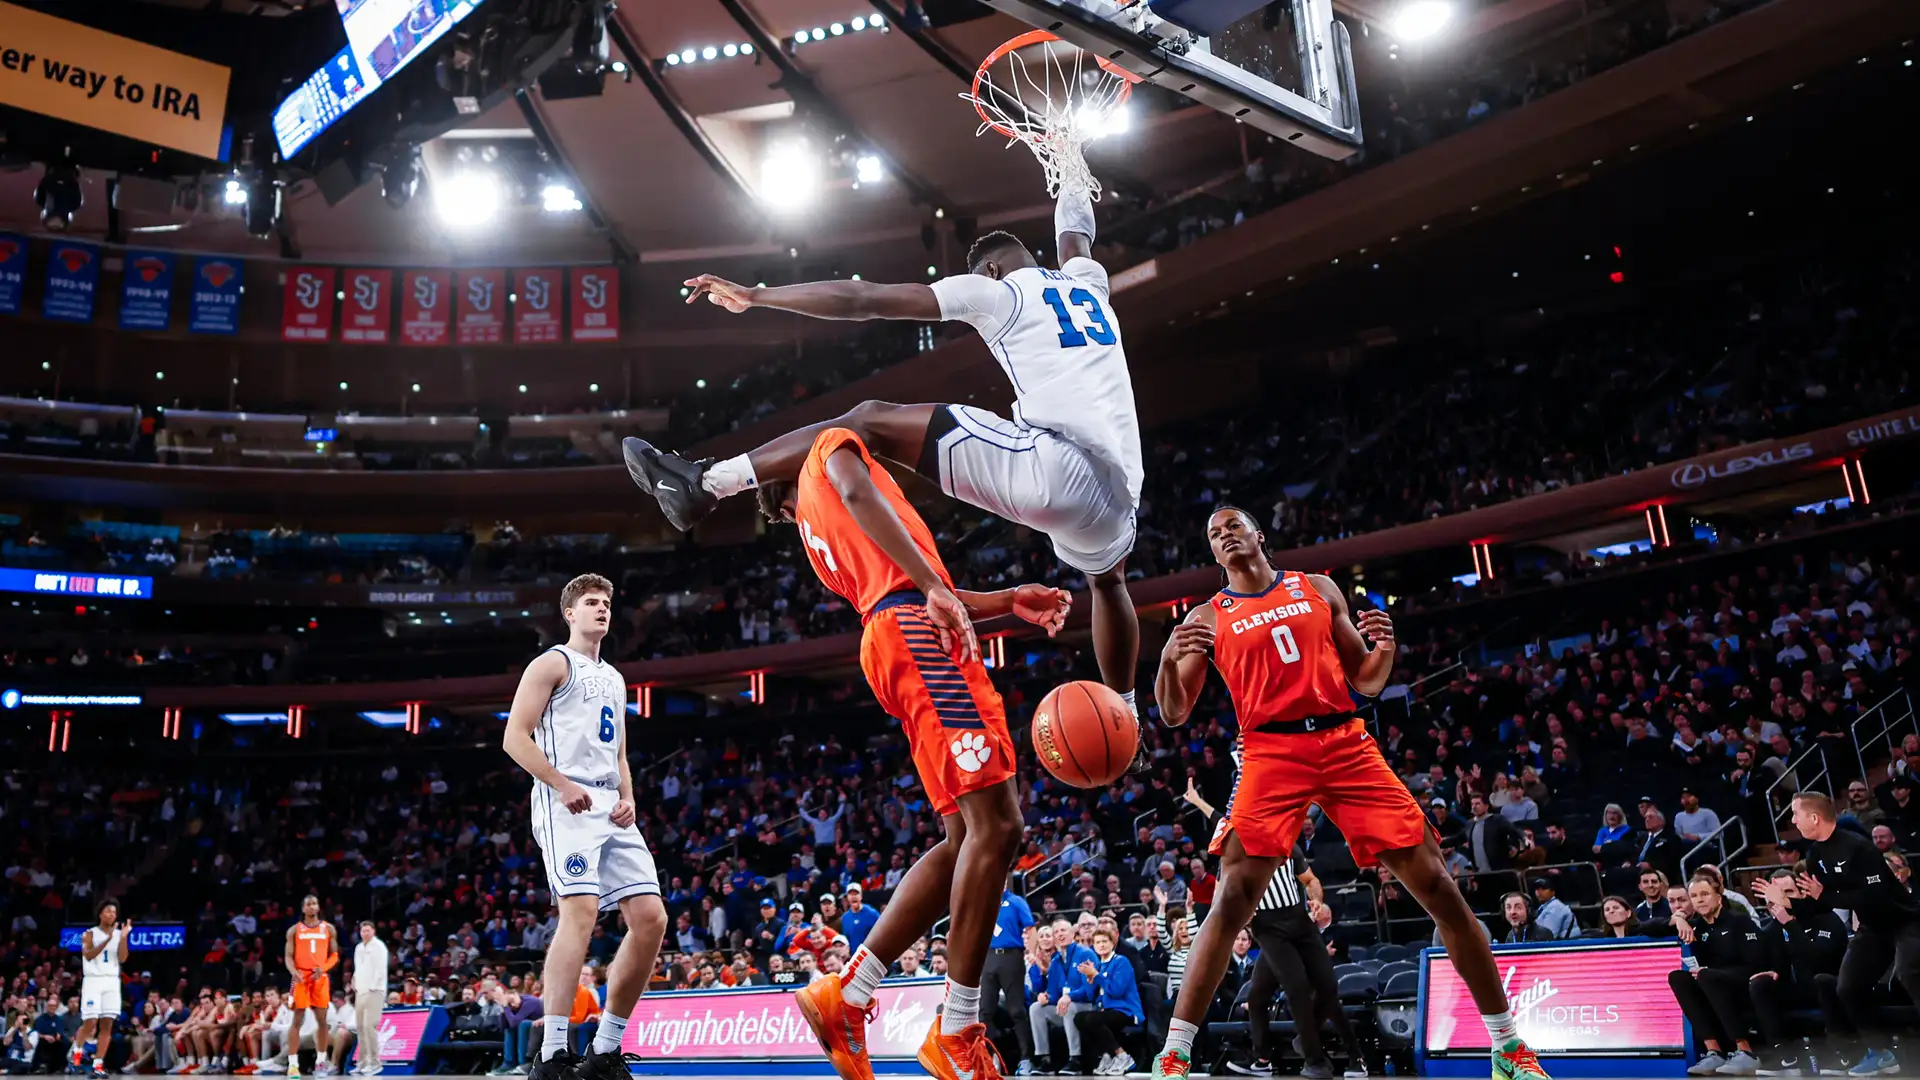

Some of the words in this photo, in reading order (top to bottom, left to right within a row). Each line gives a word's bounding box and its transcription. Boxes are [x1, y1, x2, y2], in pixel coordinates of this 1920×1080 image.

[0, 46, 35, 73] er
[43, 58, 106, 98] way
[114, 75, 144, 103] to
[152, 84, 200, 120] IRA
[1042, 288, 1117, 348] 13
[1846, 420, 1905, 446] SUITE
[1710, 441, 1814, 478] LEXUS
[398, 592, 435, 603] LIGHT
[1221, 598, 1232, 607] 41
[1231, 600, 1313, 635] CLEMSON
[1271, 624, 1301, 665] 0
[599, 705, 615, 743] 6
[1305, 718, 1316, 731] C
[129, 932, 185, 946] ULTRA
[310, 939, 317, 953] 1
[103, 950, 109, 962] 1
[774, 972, 795, 983] POSS
[1536, 1004, 1620, 1024] HOTELS
[638, 1007, 871, 1055] virginhotelslv.c
[1560, 1026, 1600, 1036] VEGAS
